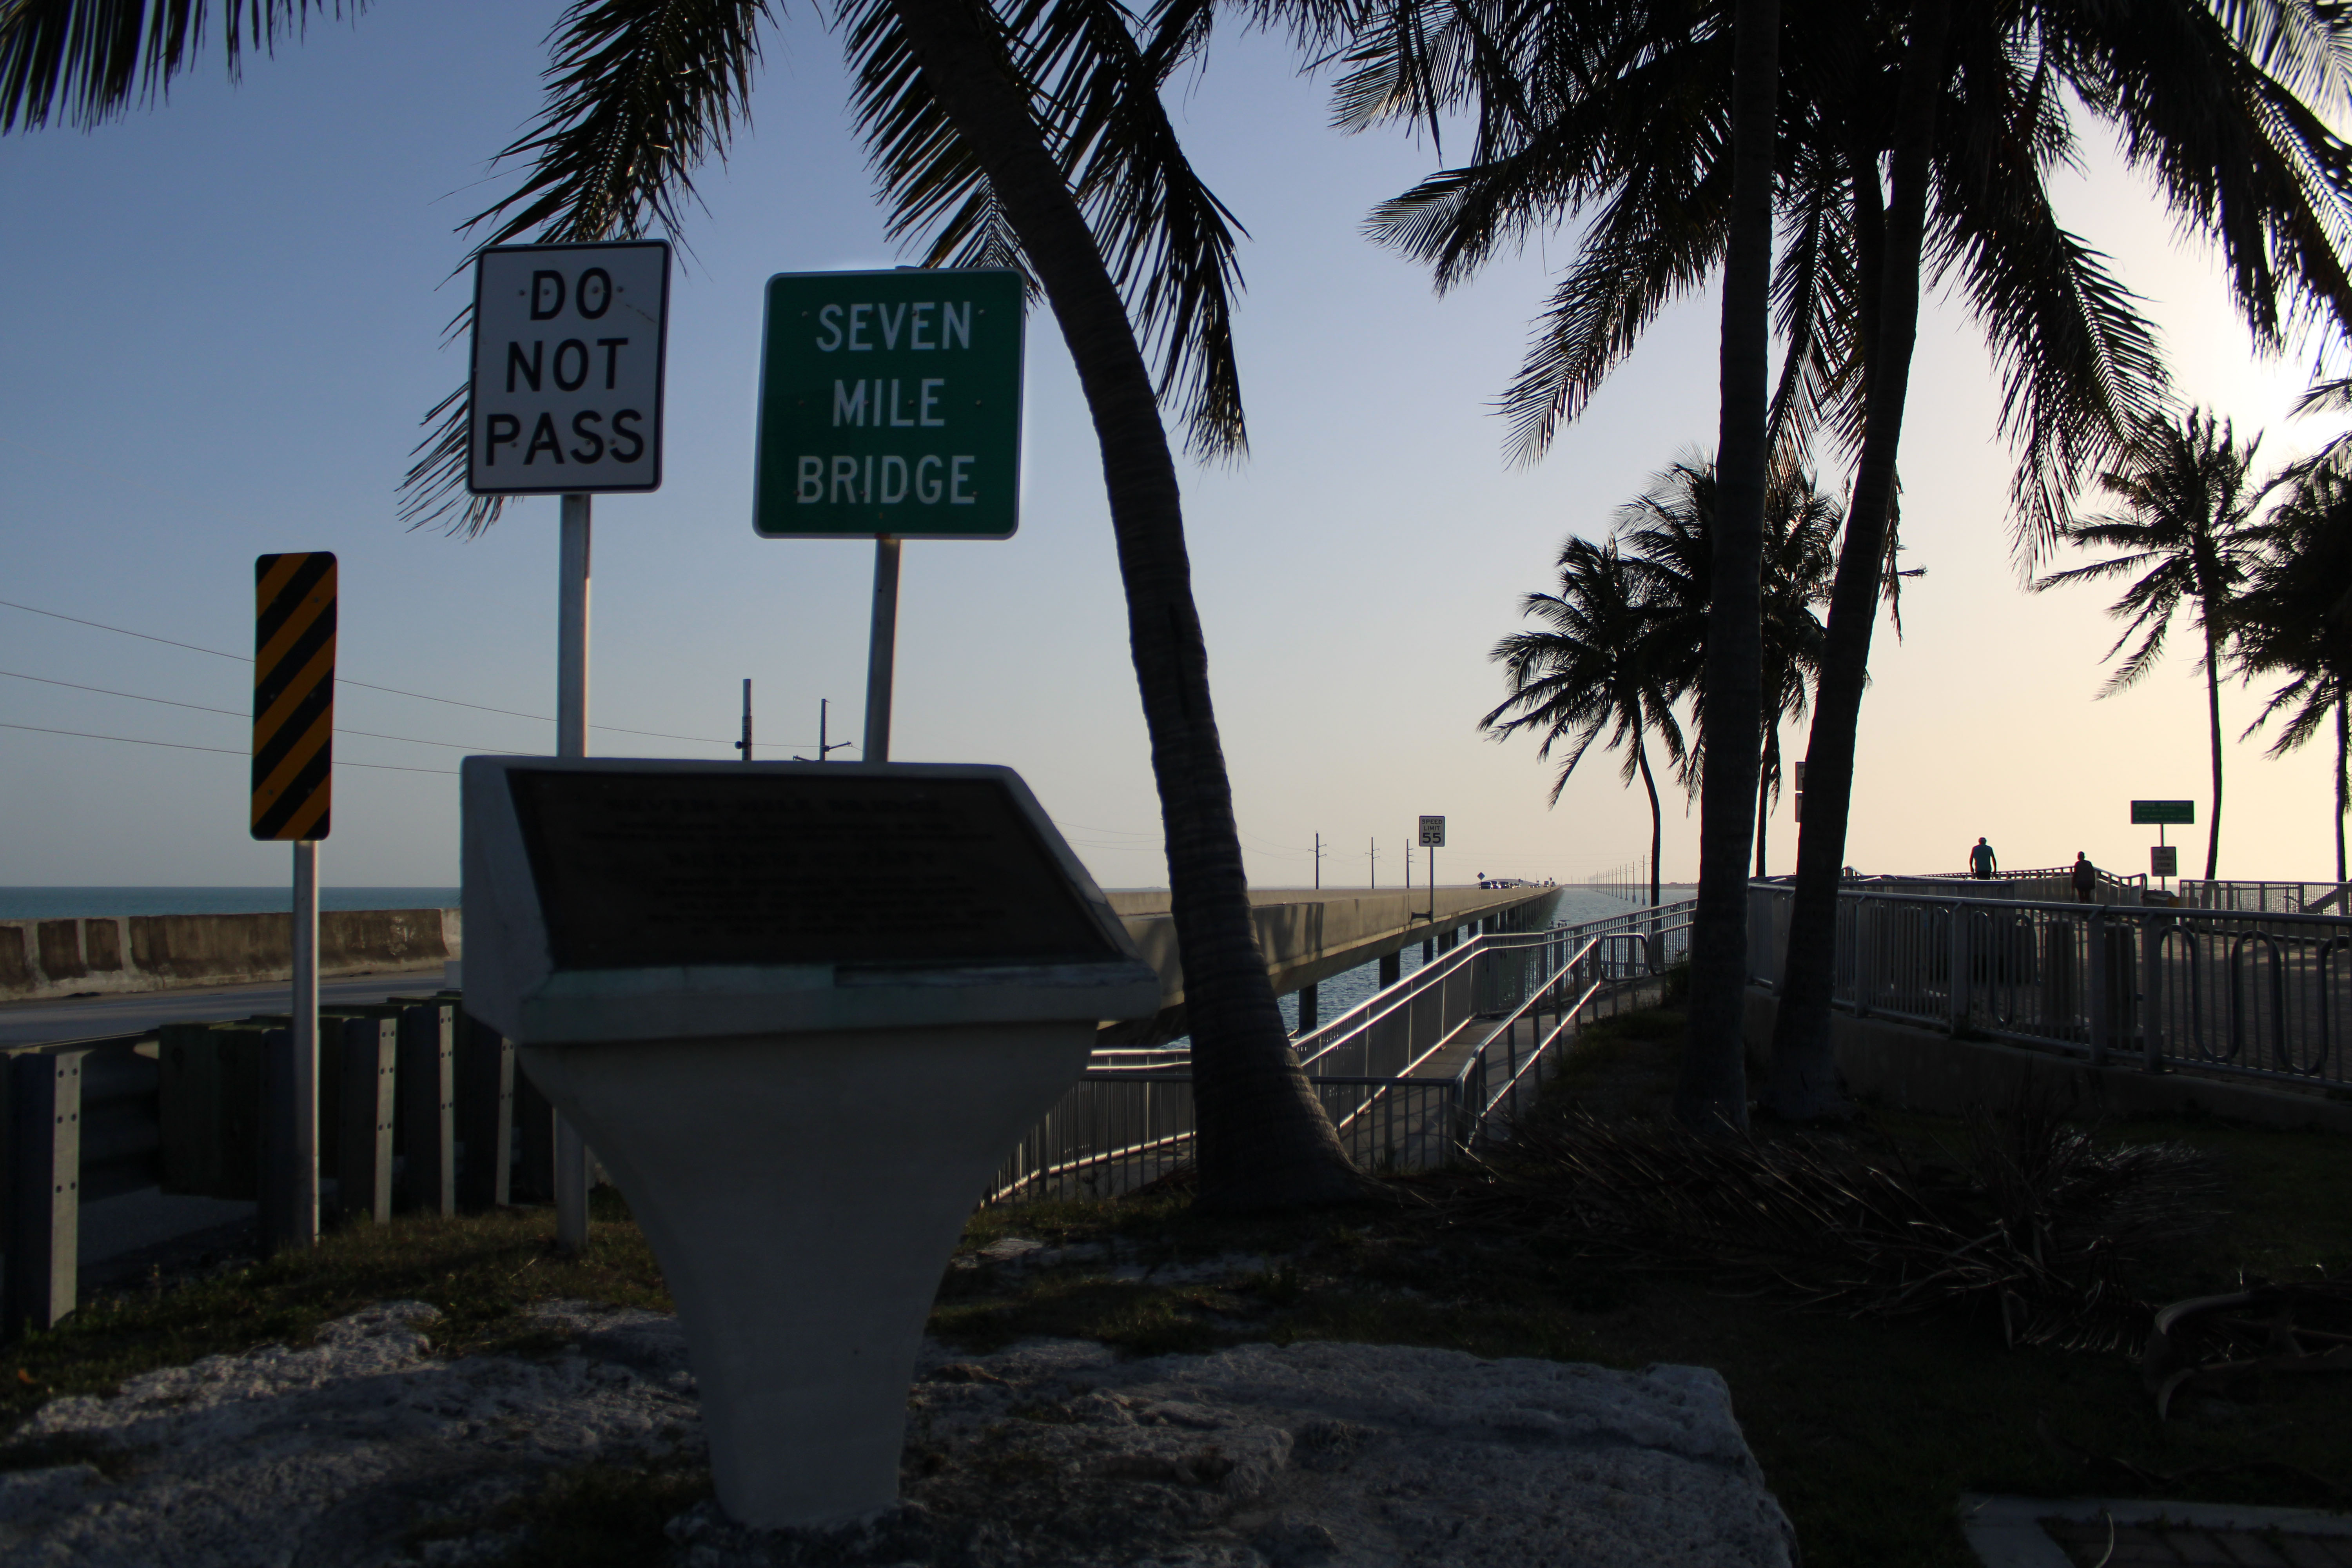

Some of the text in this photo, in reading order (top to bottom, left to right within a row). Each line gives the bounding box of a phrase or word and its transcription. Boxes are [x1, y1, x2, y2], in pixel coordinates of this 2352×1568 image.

[530, 267, 612, 321] DO
[816, 301, 970, 352] SEVEN
[506, 338, 628, 393] NOT
[833, 378, 944, 427] MILE
[486, 408, 644, 466] PASS
[797, 454, 975, 505] BRIDGE
[1422, 832, 1441, 844] 55
